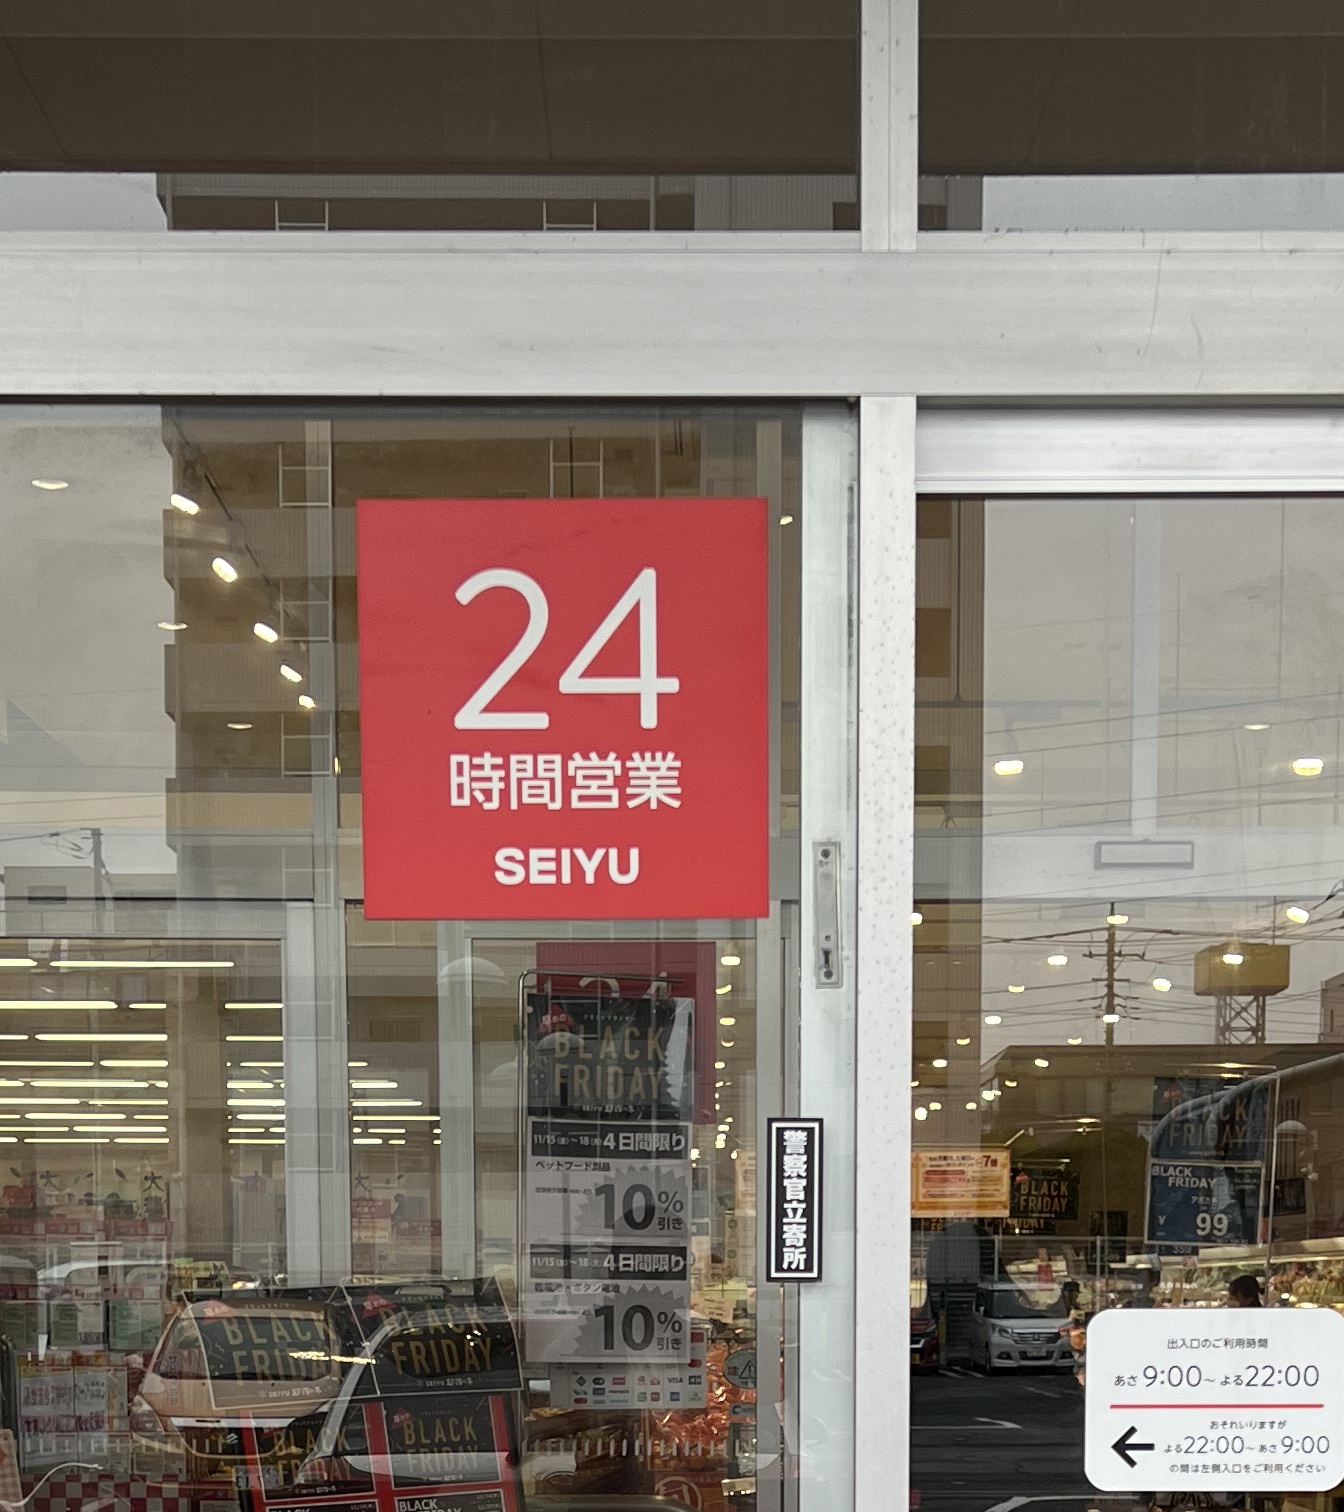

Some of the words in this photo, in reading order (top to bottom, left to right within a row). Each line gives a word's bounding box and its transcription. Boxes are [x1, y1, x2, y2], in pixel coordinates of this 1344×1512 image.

[454, 567, 680, 730] 24
[449, 752, 682, 810] 時間営業
[494, 847, 640, 886] SEIYU
[554, 1025, 665, 1061] BLACK
[554, 1064, 665, 1100] FRIDAY
[1152, 1165, 1192, 1177] BLACK
[1168, 1176, 1216, 1189] FRIDAY
[1020, 1181, 1068, 1196] BLACK
[782, 1130, 809, 1272] 警察官立寄所
[1020, 1197, 1068, 1212] FRIDAY
[658, 1217, 683, 1231] 引き
[1195, 1213, 1229, 1236] 99
[657, 1338, 682, 1351] 引き
[1167, 1338, 1269, 1350] 出入口のご利用時間
[392, 1337, 493, 1376] FRIDAY
[403, 1417, 477, 1445] BLACK
[1209, 1421, 1287, 1430] おそれいりますが
[406, 1445, 482, 1473] FRIDAY
[399, 1499, 438, 1512] BLACK
